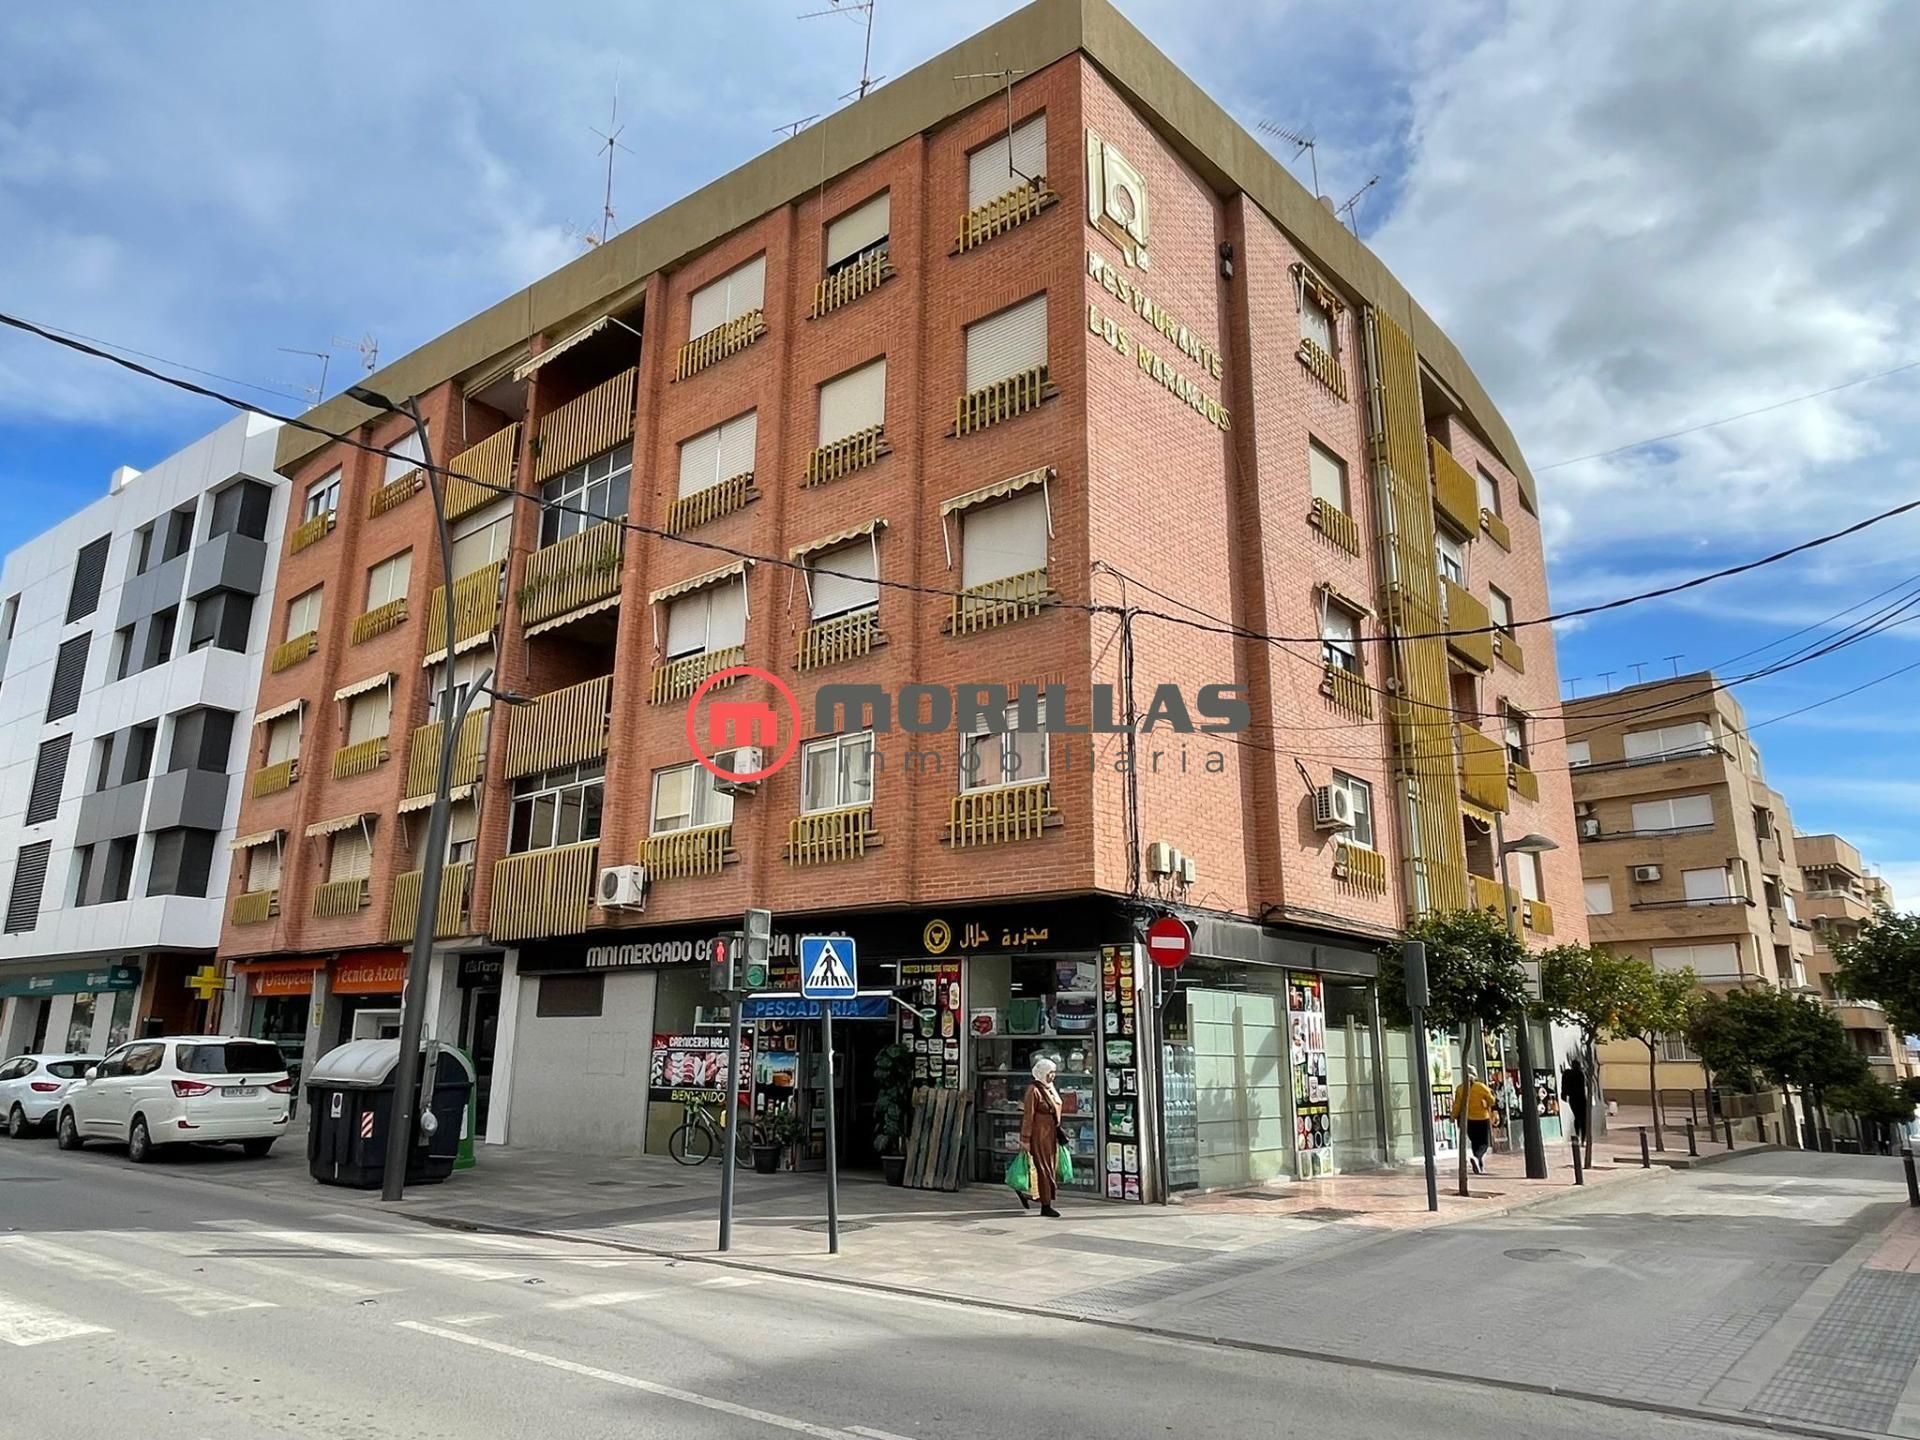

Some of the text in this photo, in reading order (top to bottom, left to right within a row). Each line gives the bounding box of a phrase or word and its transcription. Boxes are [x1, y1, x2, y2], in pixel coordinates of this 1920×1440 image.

[1087, 250, 1223, 381] RESTAURANTE
[1089, 304, 1232, 432] LOS NARANJOS
[959, 922, 1049, 949] مجزرة حلال
[336, 964, 374, 983] Técnica
[755, 1000, 860, 1017] PESCADRIA
[710, 1037, 730, 1049] HALA
